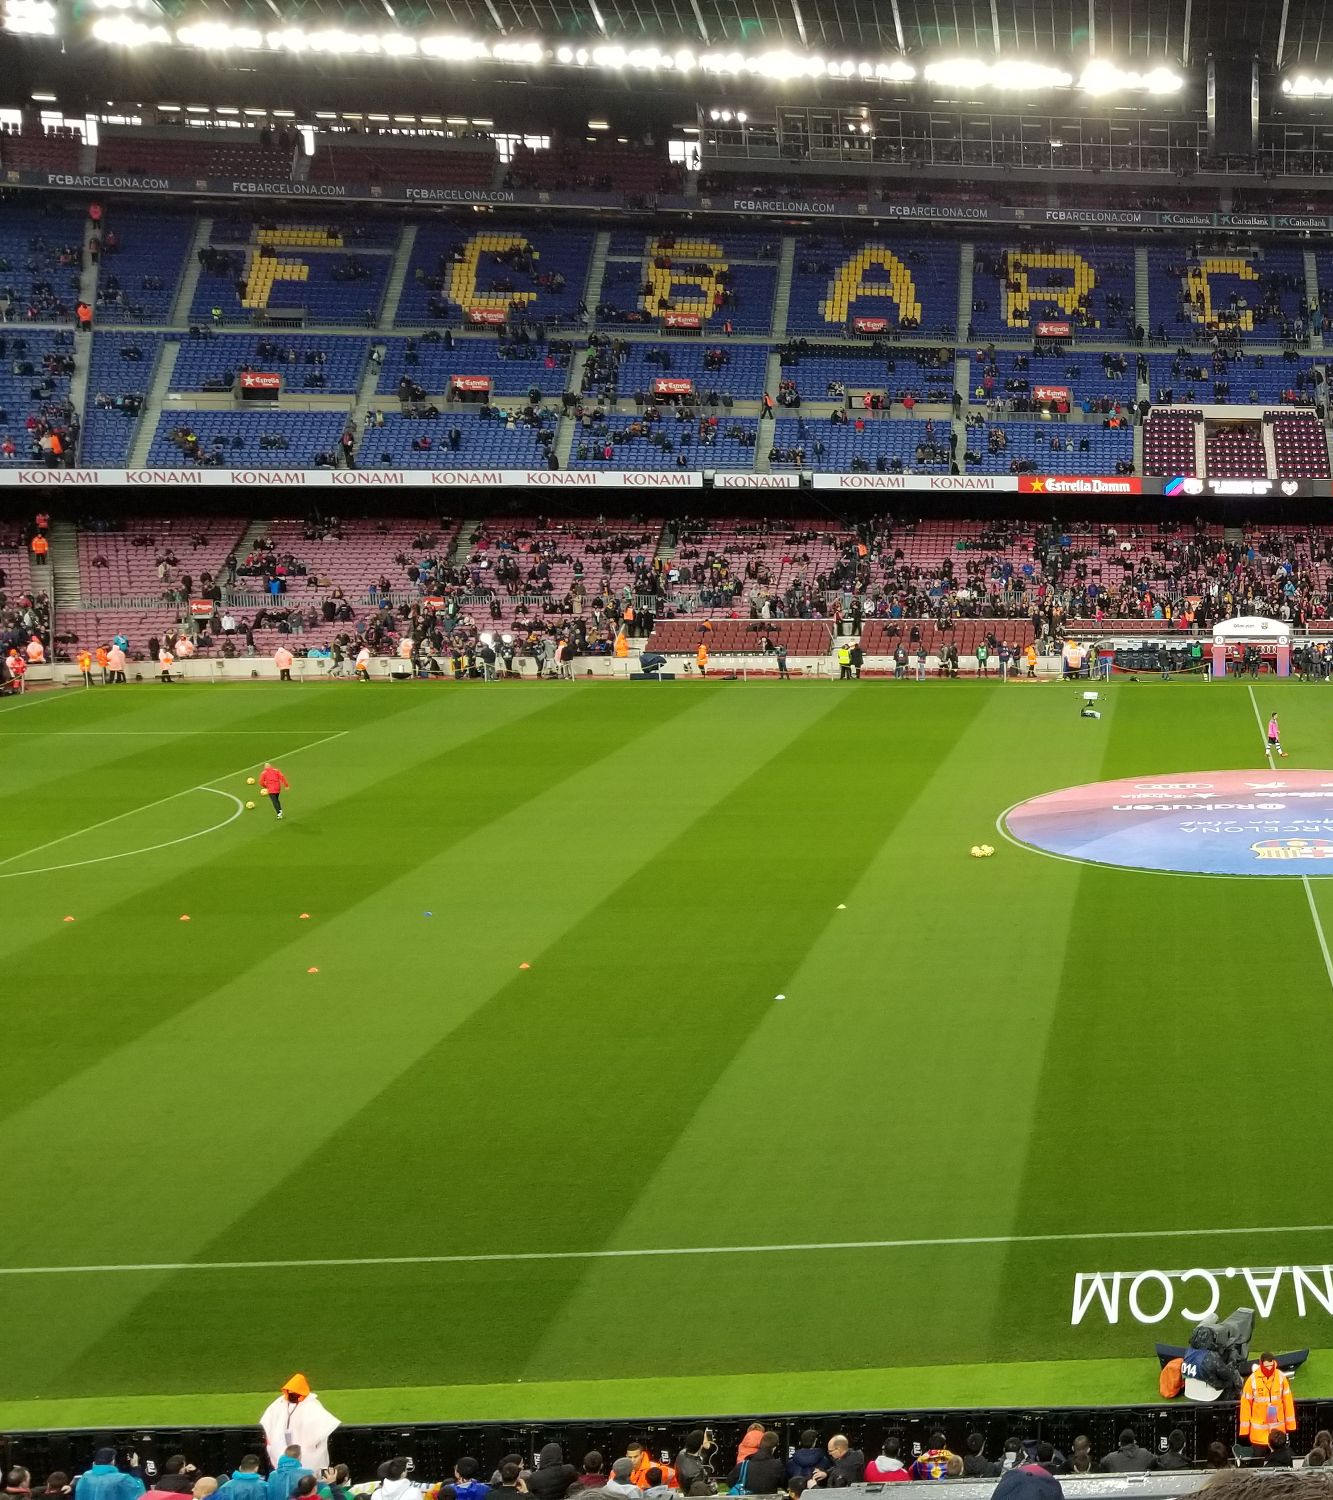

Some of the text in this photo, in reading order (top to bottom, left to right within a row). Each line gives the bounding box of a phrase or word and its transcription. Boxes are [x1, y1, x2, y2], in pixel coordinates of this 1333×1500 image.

[48, 174, 169, 189] FCBARCELONA.COM
[232, 182, 345, 195] FCBARCELONA.COM
[406, 188, 514, 201] FCBARCELONA.COM
[734, 200, 835, 213] FCBARCELONA.COM
[889, 205, 988, 218] FCBARCELONA.COM
[1046, 211, 1141, 223] FCBARCELONA.COM
[1173, 215, 1210, 225] CaixaBank
[1231, 215, 1268, 226] CaixaBank
[1289, 217, 1326, 228] CaixaBank
[18, 471, 99, 483] KONAMI
[126, 472, 202, 483] KONAMI
[231, 473, 305, 484] KONAMI
[331, 473, 404, 484] KONAMI
[432, 473, 502, 484] KONAMI
[527, 473, 597, 484] KONAMI
[622, 474, 691, 485] KONAMI
[722, 476, 790, 489] KONAMI
[840, 477, 905, 488] KONAMI
[930, 479, 994, 489] KONAMI
[1045, 478, 1131, 492] Estrella Damm
[1112, 803, 1250, 811] Rakuten
